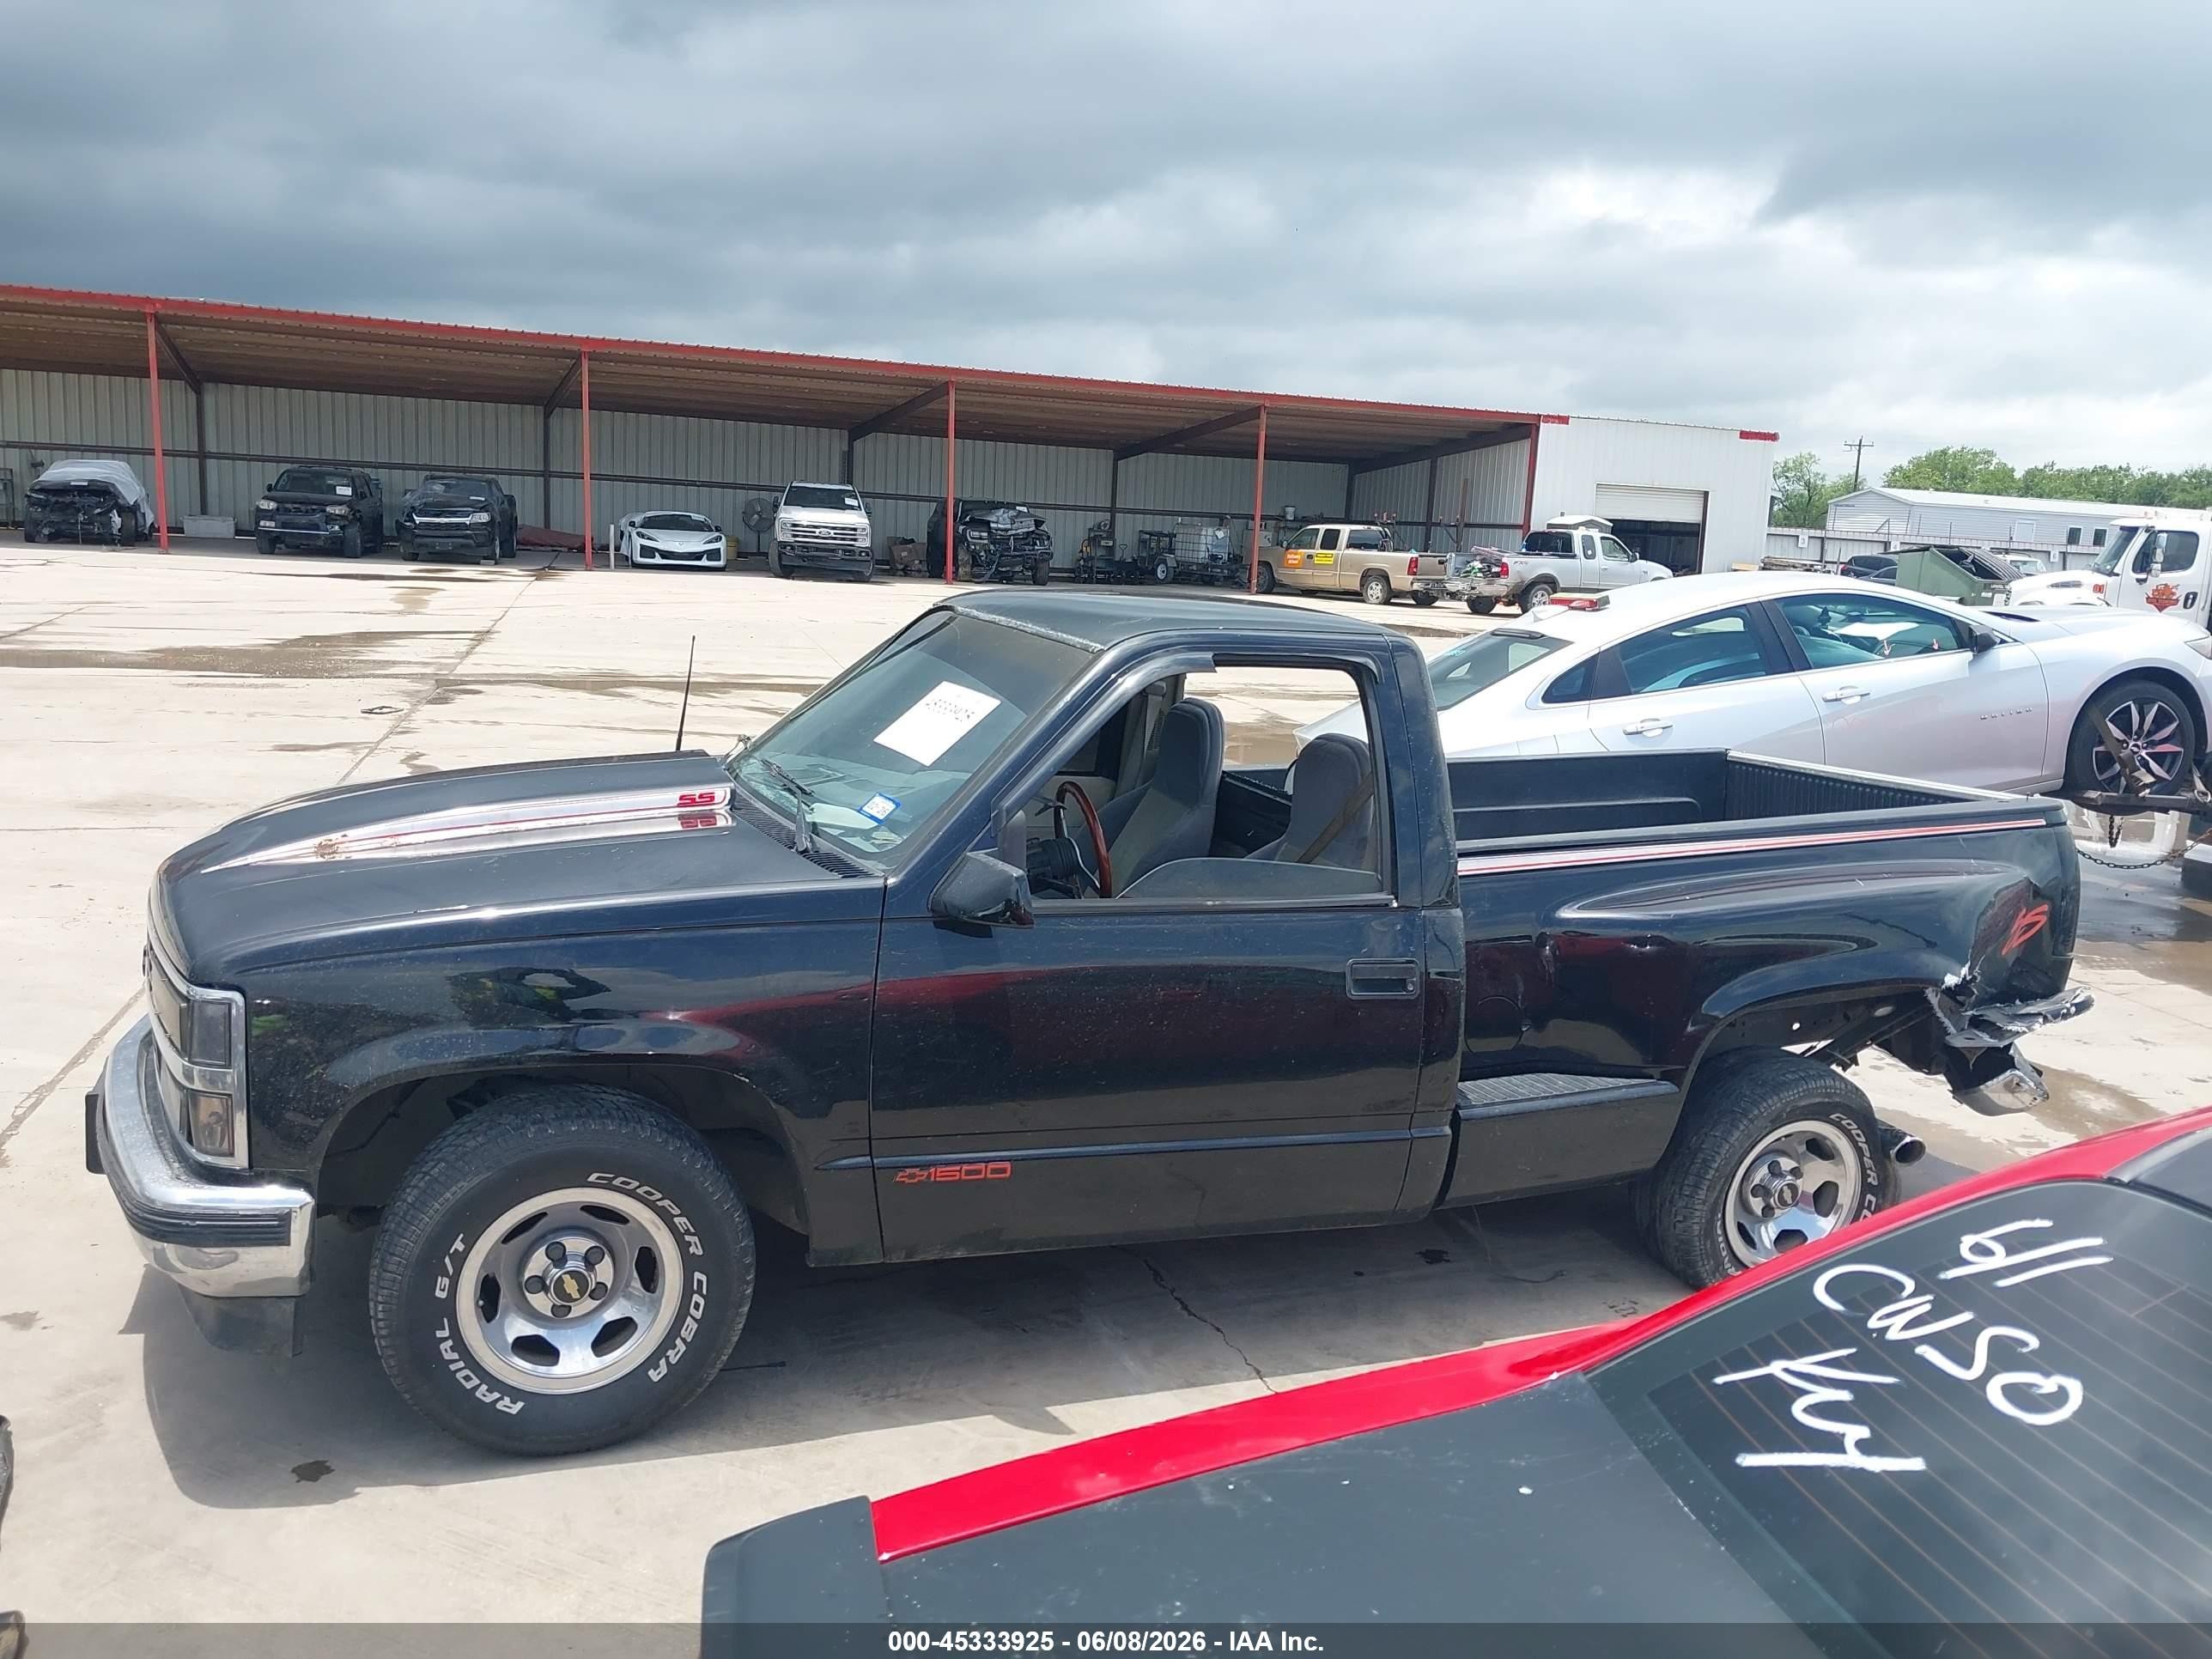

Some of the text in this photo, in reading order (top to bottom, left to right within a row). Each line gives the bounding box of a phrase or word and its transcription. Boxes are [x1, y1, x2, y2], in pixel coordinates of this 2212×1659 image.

[677, 792, 715, 807] SS
[927, 1161, 1013, 1182] 1500
[1828, 1113, 1879, 1187] COOPER
[586, 1171, 708, 1384] COOPER COBRA
[434, 1232, 526, 1415] RADIAL G/T
